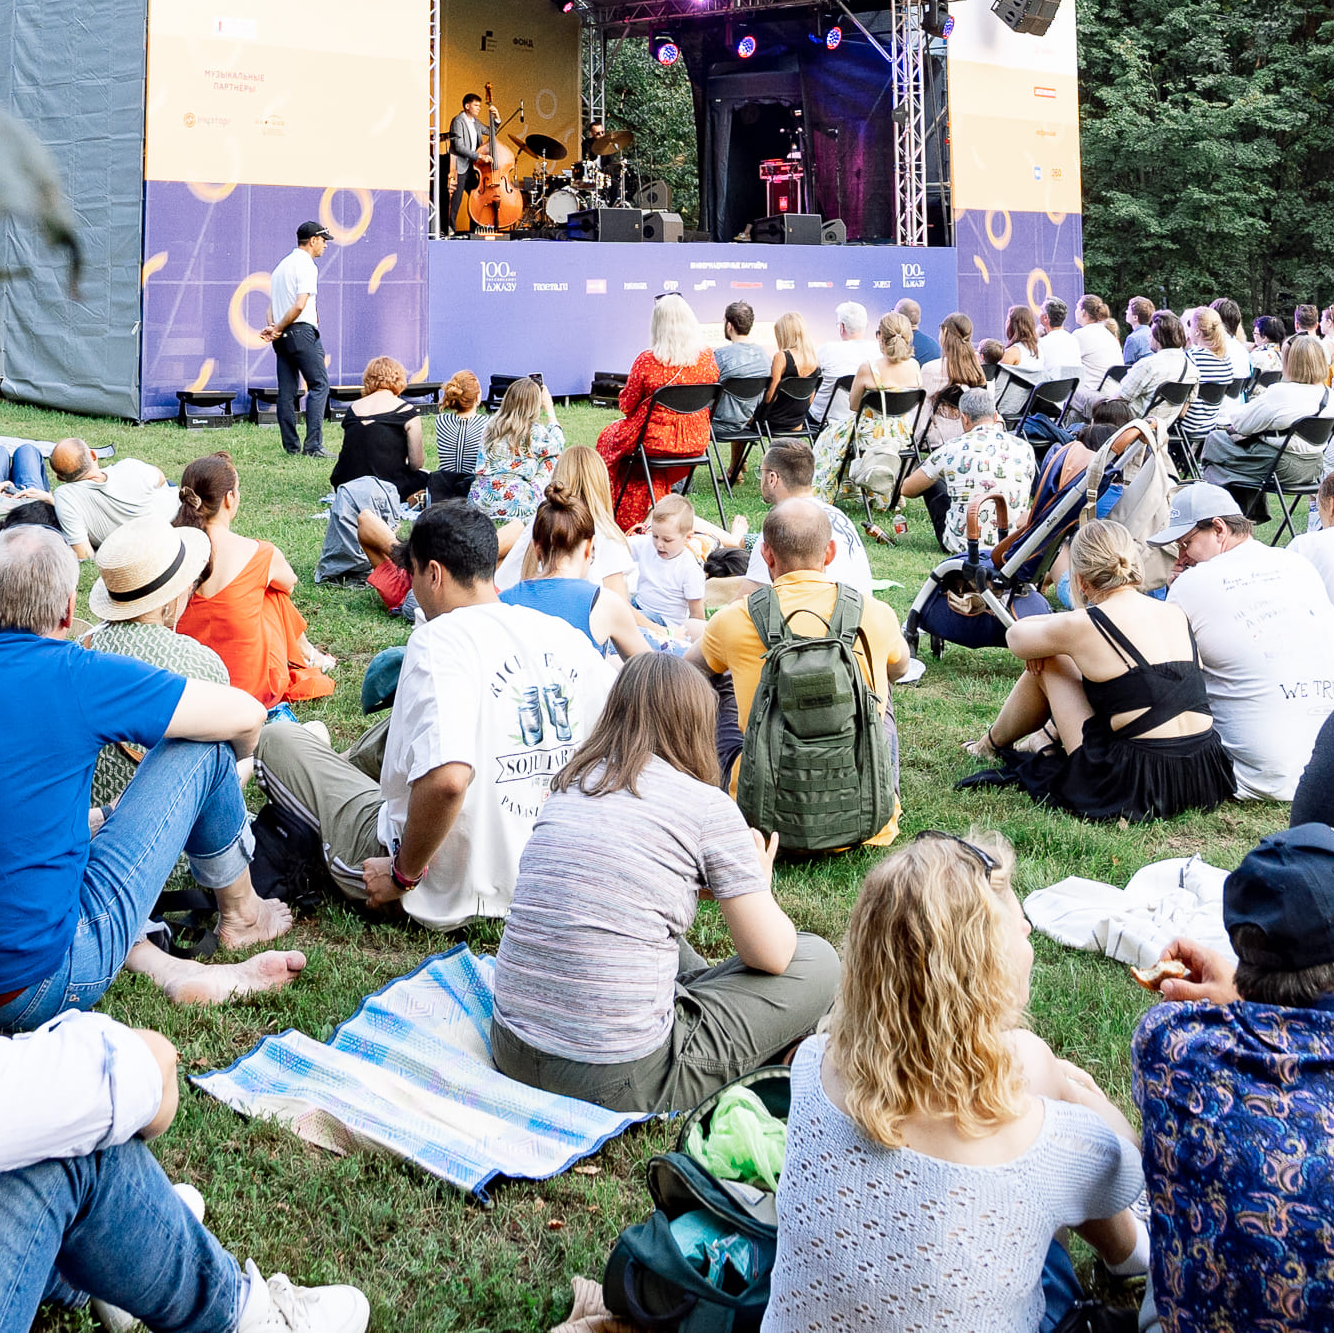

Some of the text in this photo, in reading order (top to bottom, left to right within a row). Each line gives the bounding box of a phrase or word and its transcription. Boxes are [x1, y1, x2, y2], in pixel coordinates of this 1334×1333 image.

[204, 69, 265, 82] МУЗЫКАЛЬНЫЕ
[480, 261, 510, 291] 100
[486, 282, 517, 292] ДЖАЗУ
[1279, 681, 1308, 700] WE
[506, 754, 543, 776] SOJU
